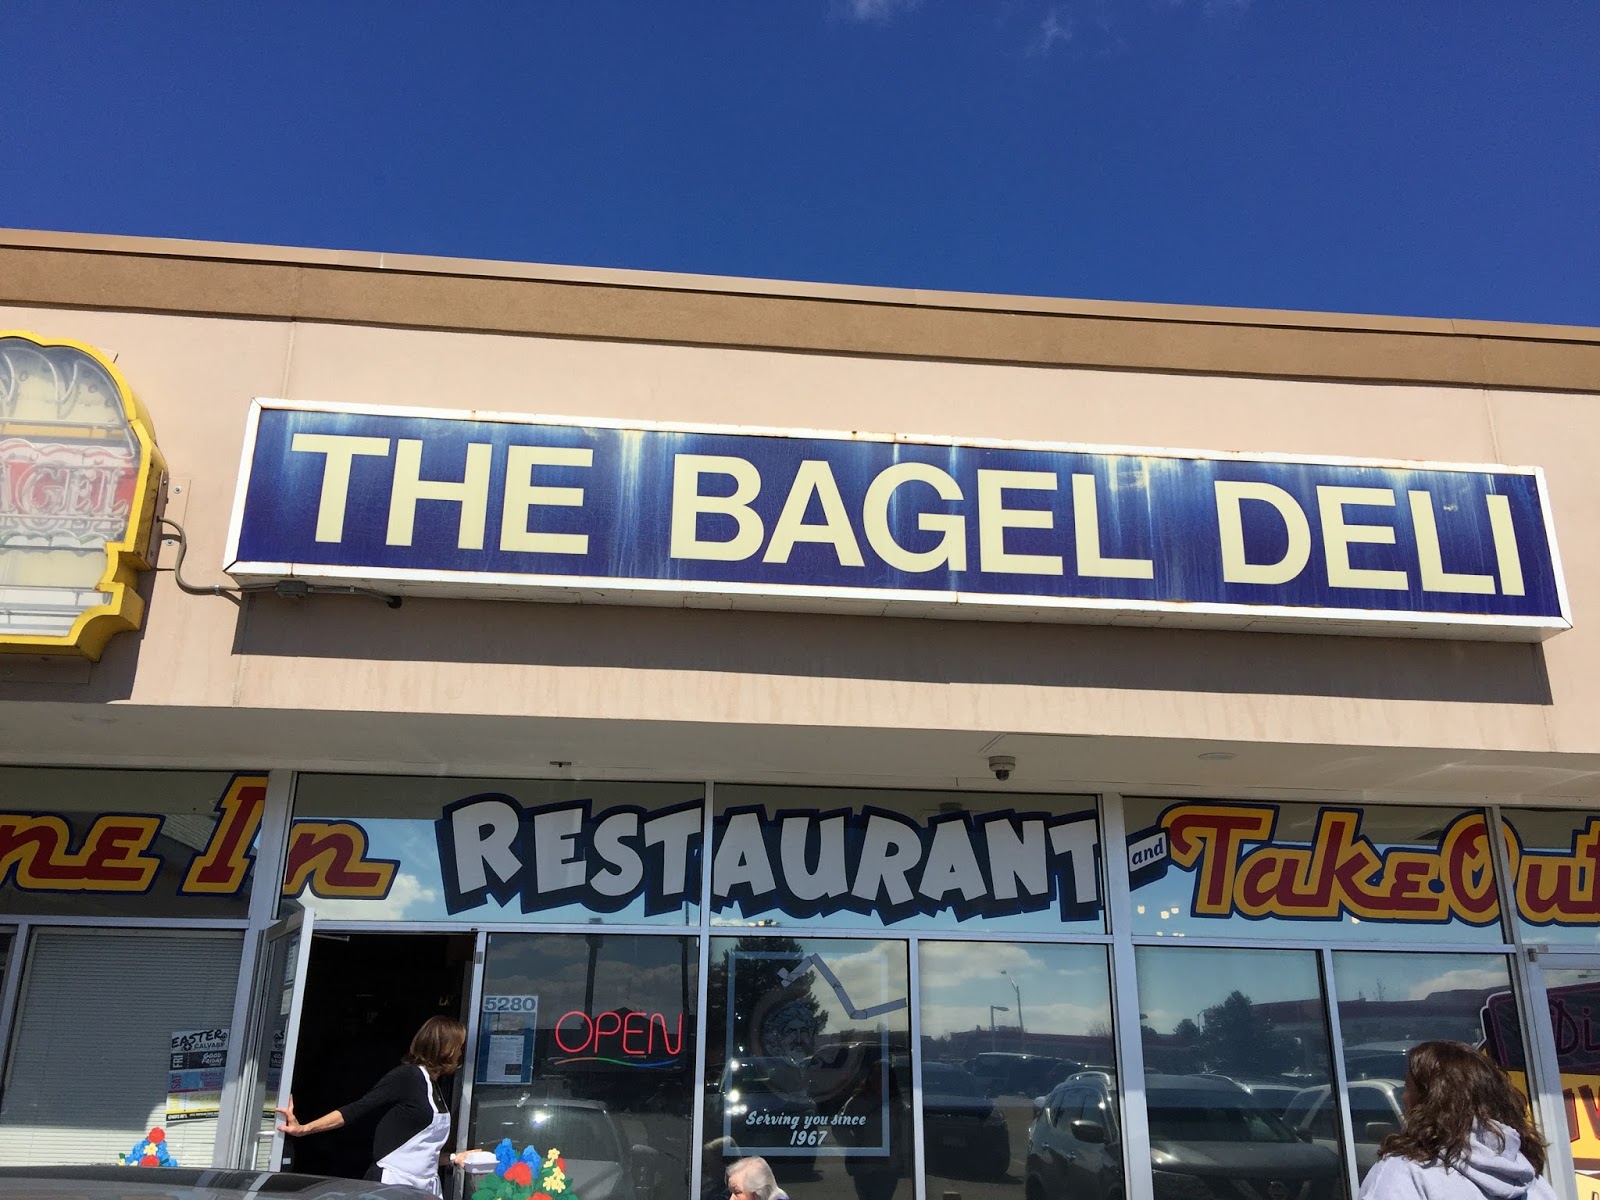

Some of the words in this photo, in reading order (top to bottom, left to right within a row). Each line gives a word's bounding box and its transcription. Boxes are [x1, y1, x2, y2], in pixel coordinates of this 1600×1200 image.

[0, 464, 104, 516] GEL
[292, 433, 593, 554] THE
[670, 453, 1155, 580] BAGEL
[1213, 480, 1526, 596] DELI
[178, 774, 398, 897] In
[440, 795, 1102, 917] RESTAURANT
[1131, 842, 1165, 866] and
[484, 997, 536, 1012] 5280
[555, 1010, 684, 1055] OPEN
[173, 1055, 184, 1068] FRI
[201, 1057, 223, 1065] FRIDAY
[203, 1052, 221, 1060] GOOD
[171, 1074, 181, 1089] SAT
[746, 1111, 800, 1129] Serving
[804, 1116, 829, 1129] you
[831, 1111, 866, 1125] since
[790, 1130, 828, 1146] 1967
